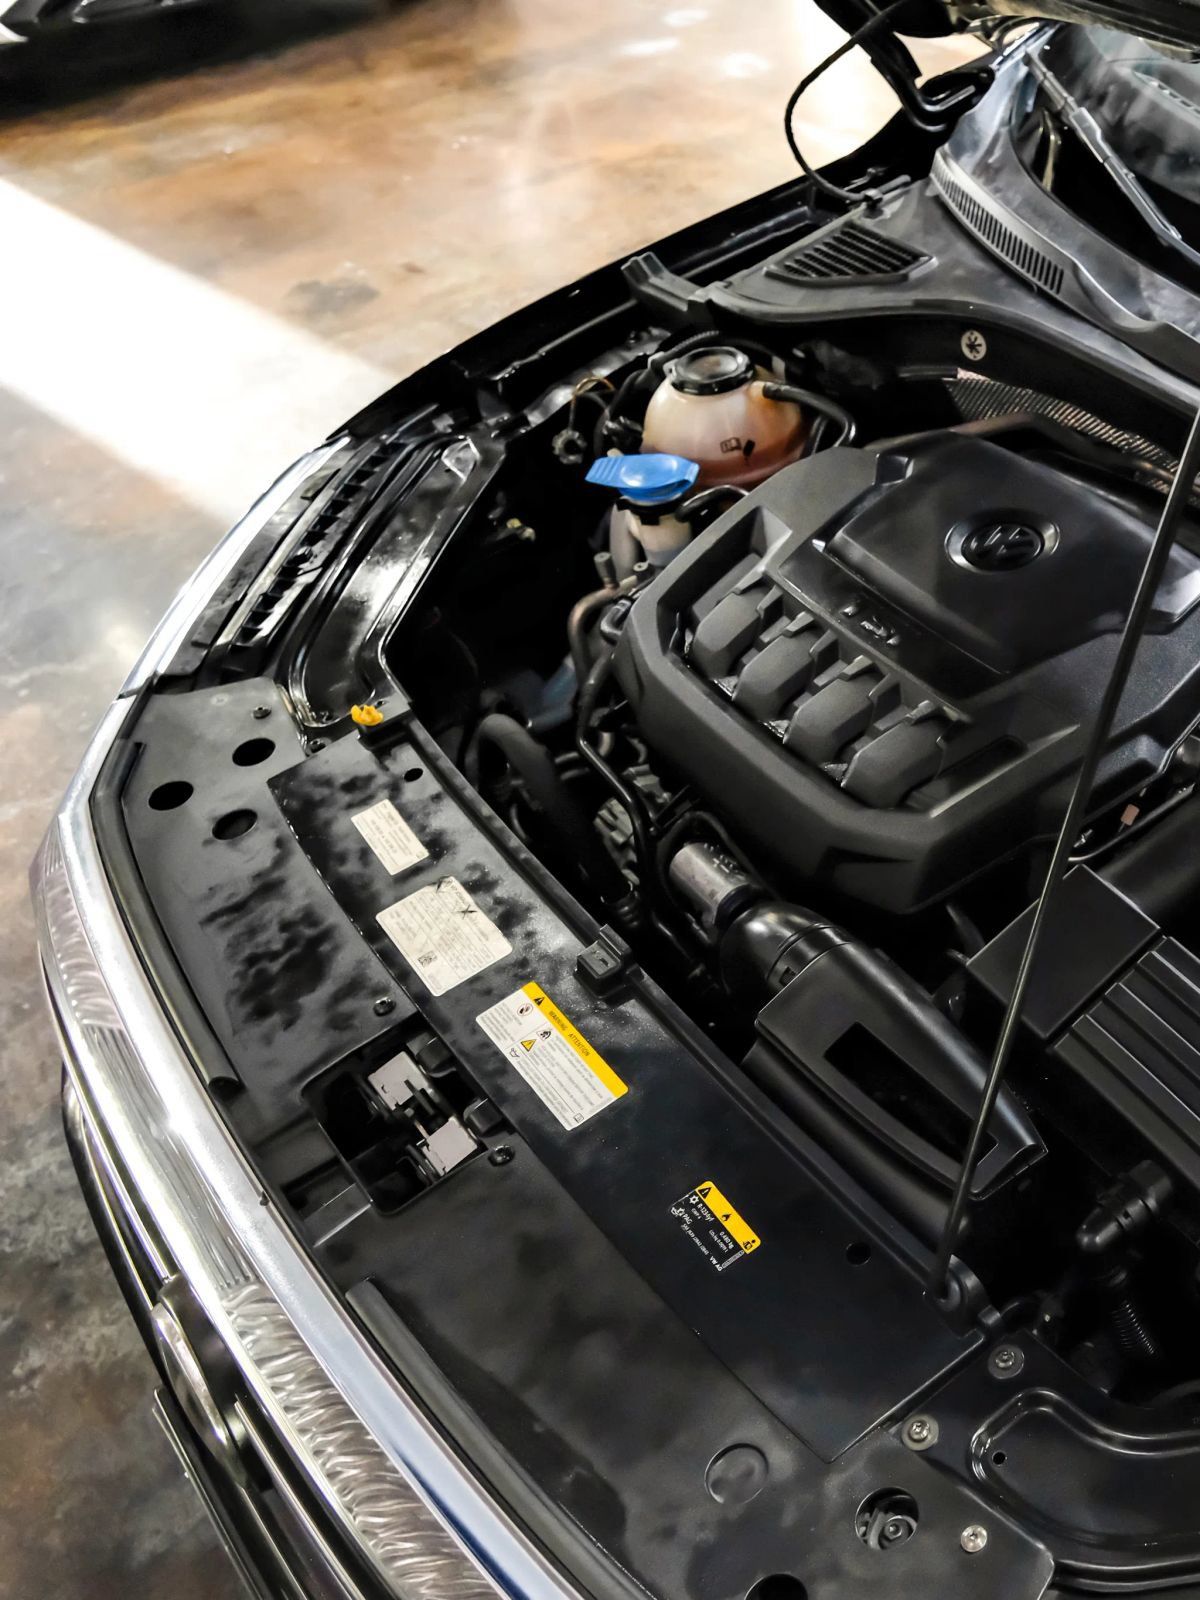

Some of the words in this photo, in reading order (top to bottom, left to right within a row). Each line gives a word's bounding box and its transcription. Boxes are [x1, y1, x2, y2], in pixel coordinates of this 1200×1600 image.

[567, 1032, 591, 1057] ATTENTION
[684, 1214, 692, 1224] PAG
[697, 1203, 714, 1222] R-1234yf
[709, 1255, 717, 1265] VW
[714, 1262, 723, 1272] AG
